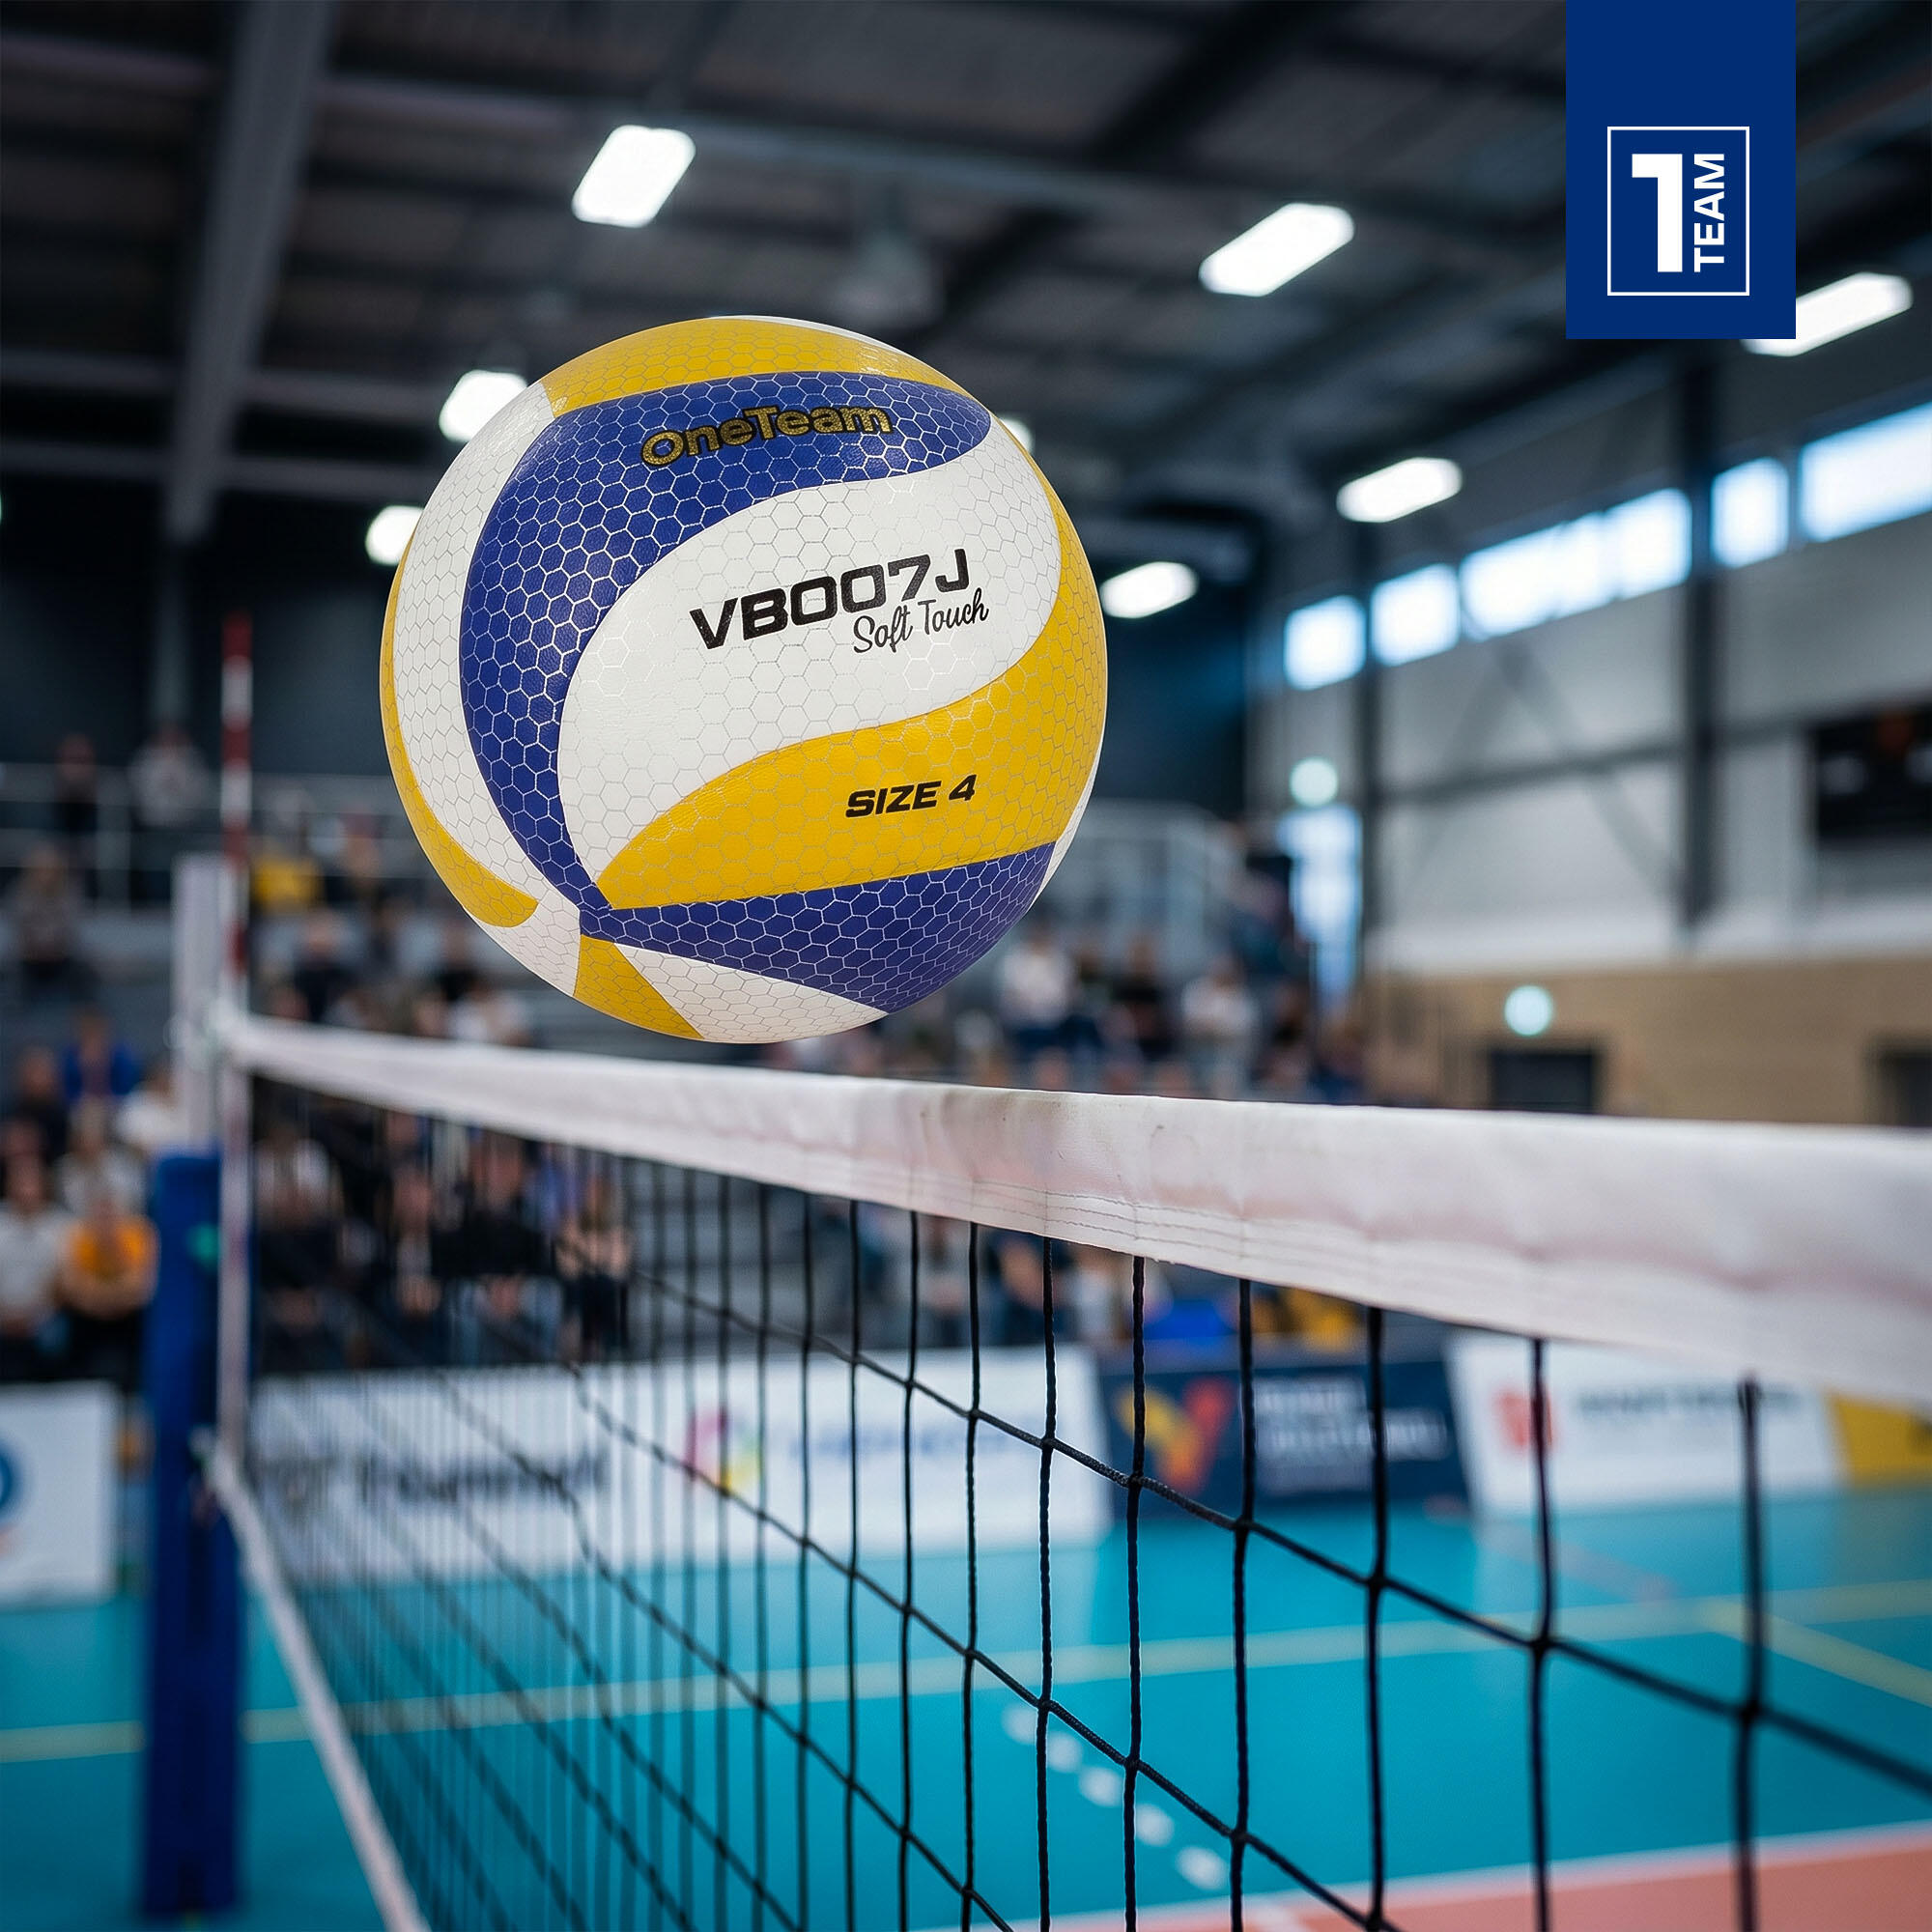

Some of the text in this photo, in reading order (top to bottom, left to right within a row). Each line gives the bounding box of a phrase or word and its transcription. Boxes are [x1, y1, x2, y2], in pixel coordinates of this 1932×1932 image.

[640, 405, 892, 467] OneTeam
[690, 548, 970, 650] VB007J
[853, 587, 989, 653] Soft Touch
[845, 774, 977, 818] SIZE 4
